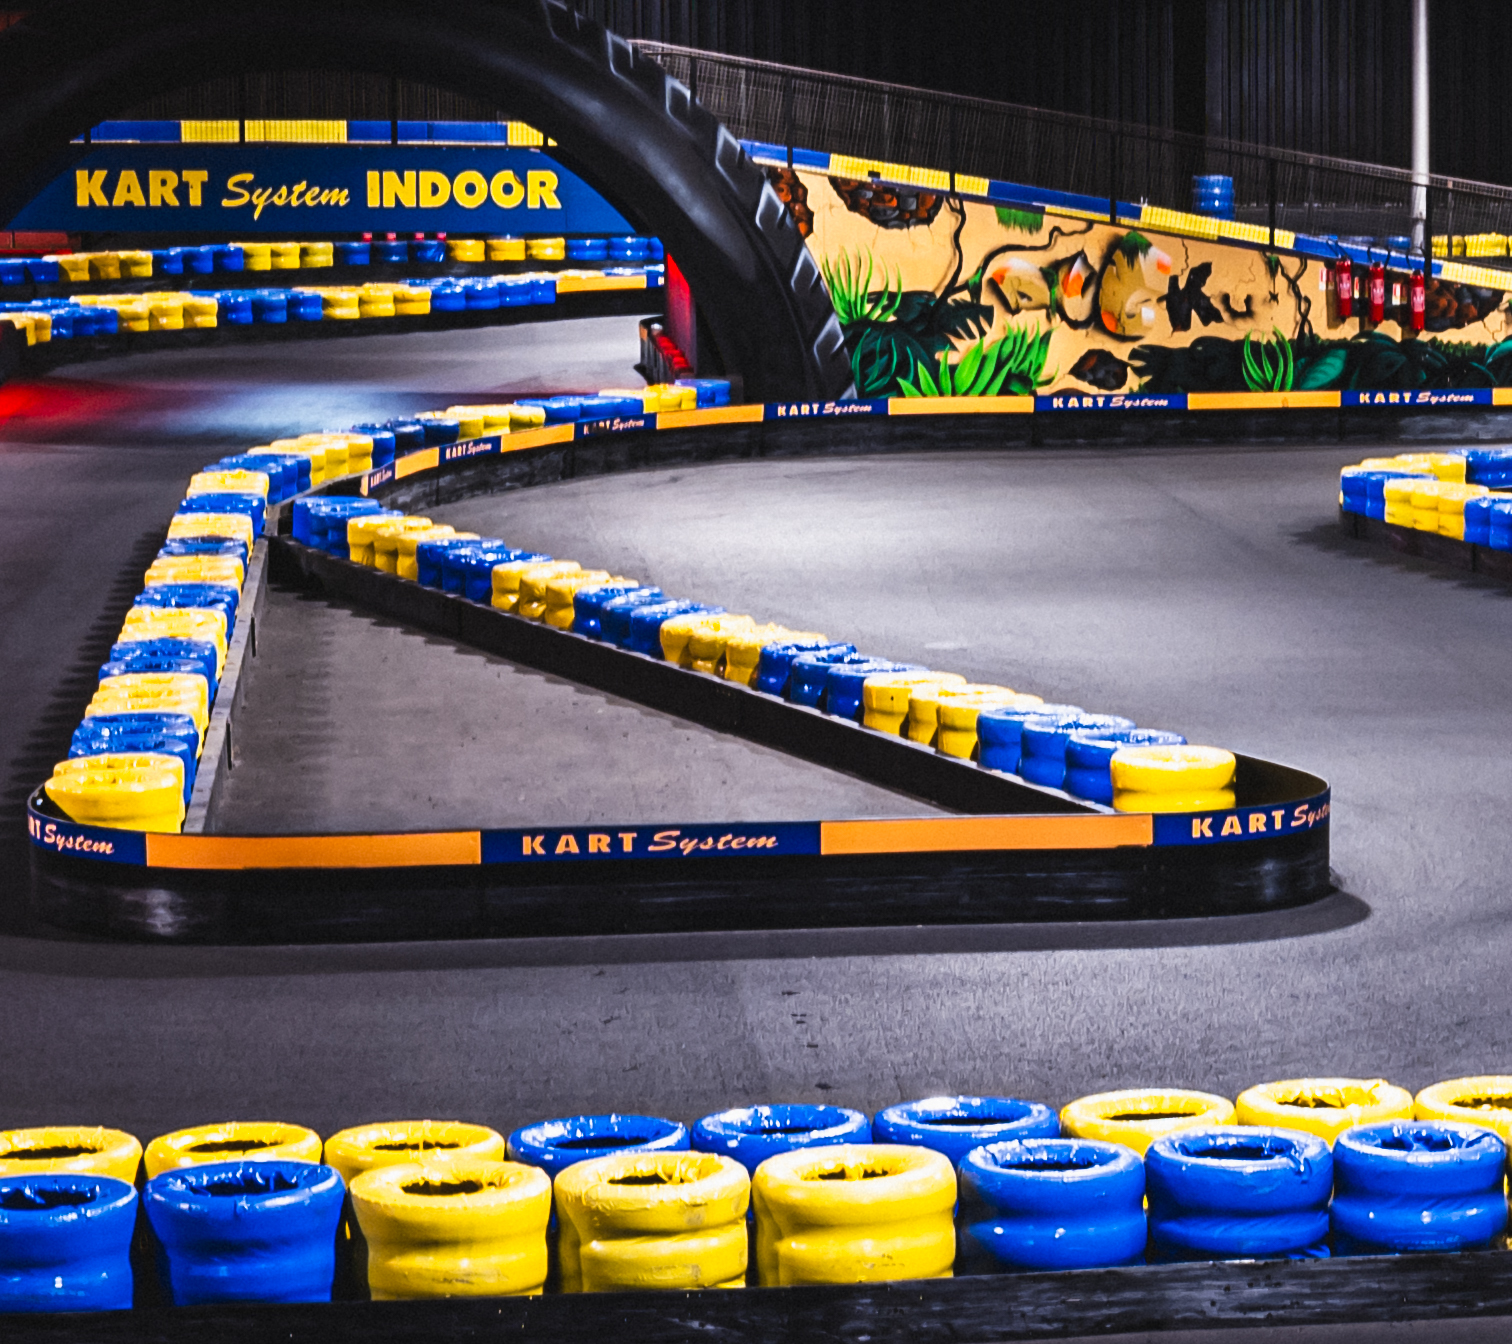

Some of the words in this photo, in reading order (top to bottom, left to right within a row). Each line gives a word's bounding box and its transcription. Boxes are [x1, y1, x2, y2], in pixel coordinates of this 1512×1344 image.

[75, 169, 209, 208] KART
[221, 172, 350, 221] System
[366, 169, 562, 210] INDOOR
[777, 402, 820, 417] KART
[822, 401, 873, 416] System
[1052, 396, 1106, 409] KART
[1109, 395, 1169, 409] System
[1358, 391, 1412, 404] KART
[1415, 390, 1475, 405] System
[1191, 809, 1285, 839] KART
[43, 823, 115, 855] System
[521, 831, 638, 856] KART
[647, 829, 779, 856] System
